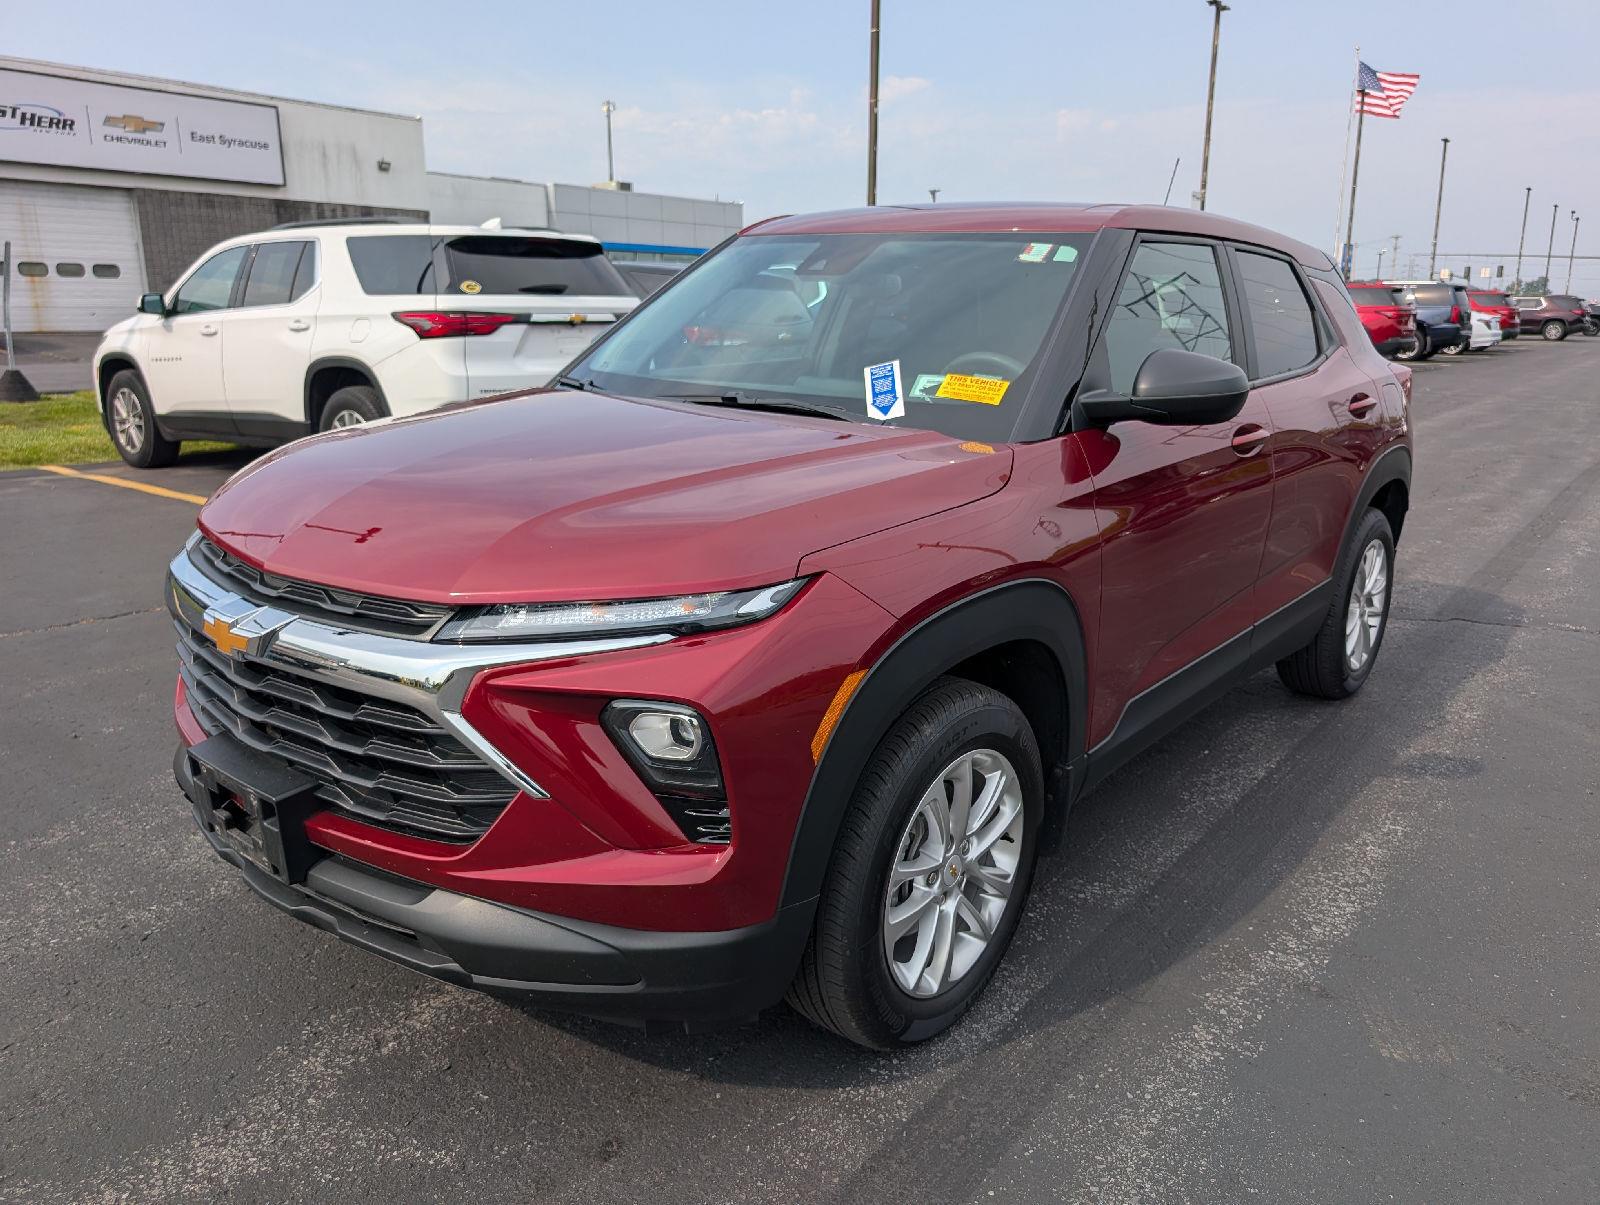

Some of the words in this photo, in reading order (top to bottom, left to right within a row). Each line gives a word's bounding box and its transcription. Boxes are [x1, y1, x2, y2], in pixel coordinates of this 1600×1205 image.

[20, 112, 76, 132] HERR
[103, 133, 168, 148] CHEVROLET
[190, 131, 216, 144] East
[218, 134, 270, 150] Syracuse
[949, 375, 968, 383] THIS
[970, 377, 1005, 388] VEHICLE
